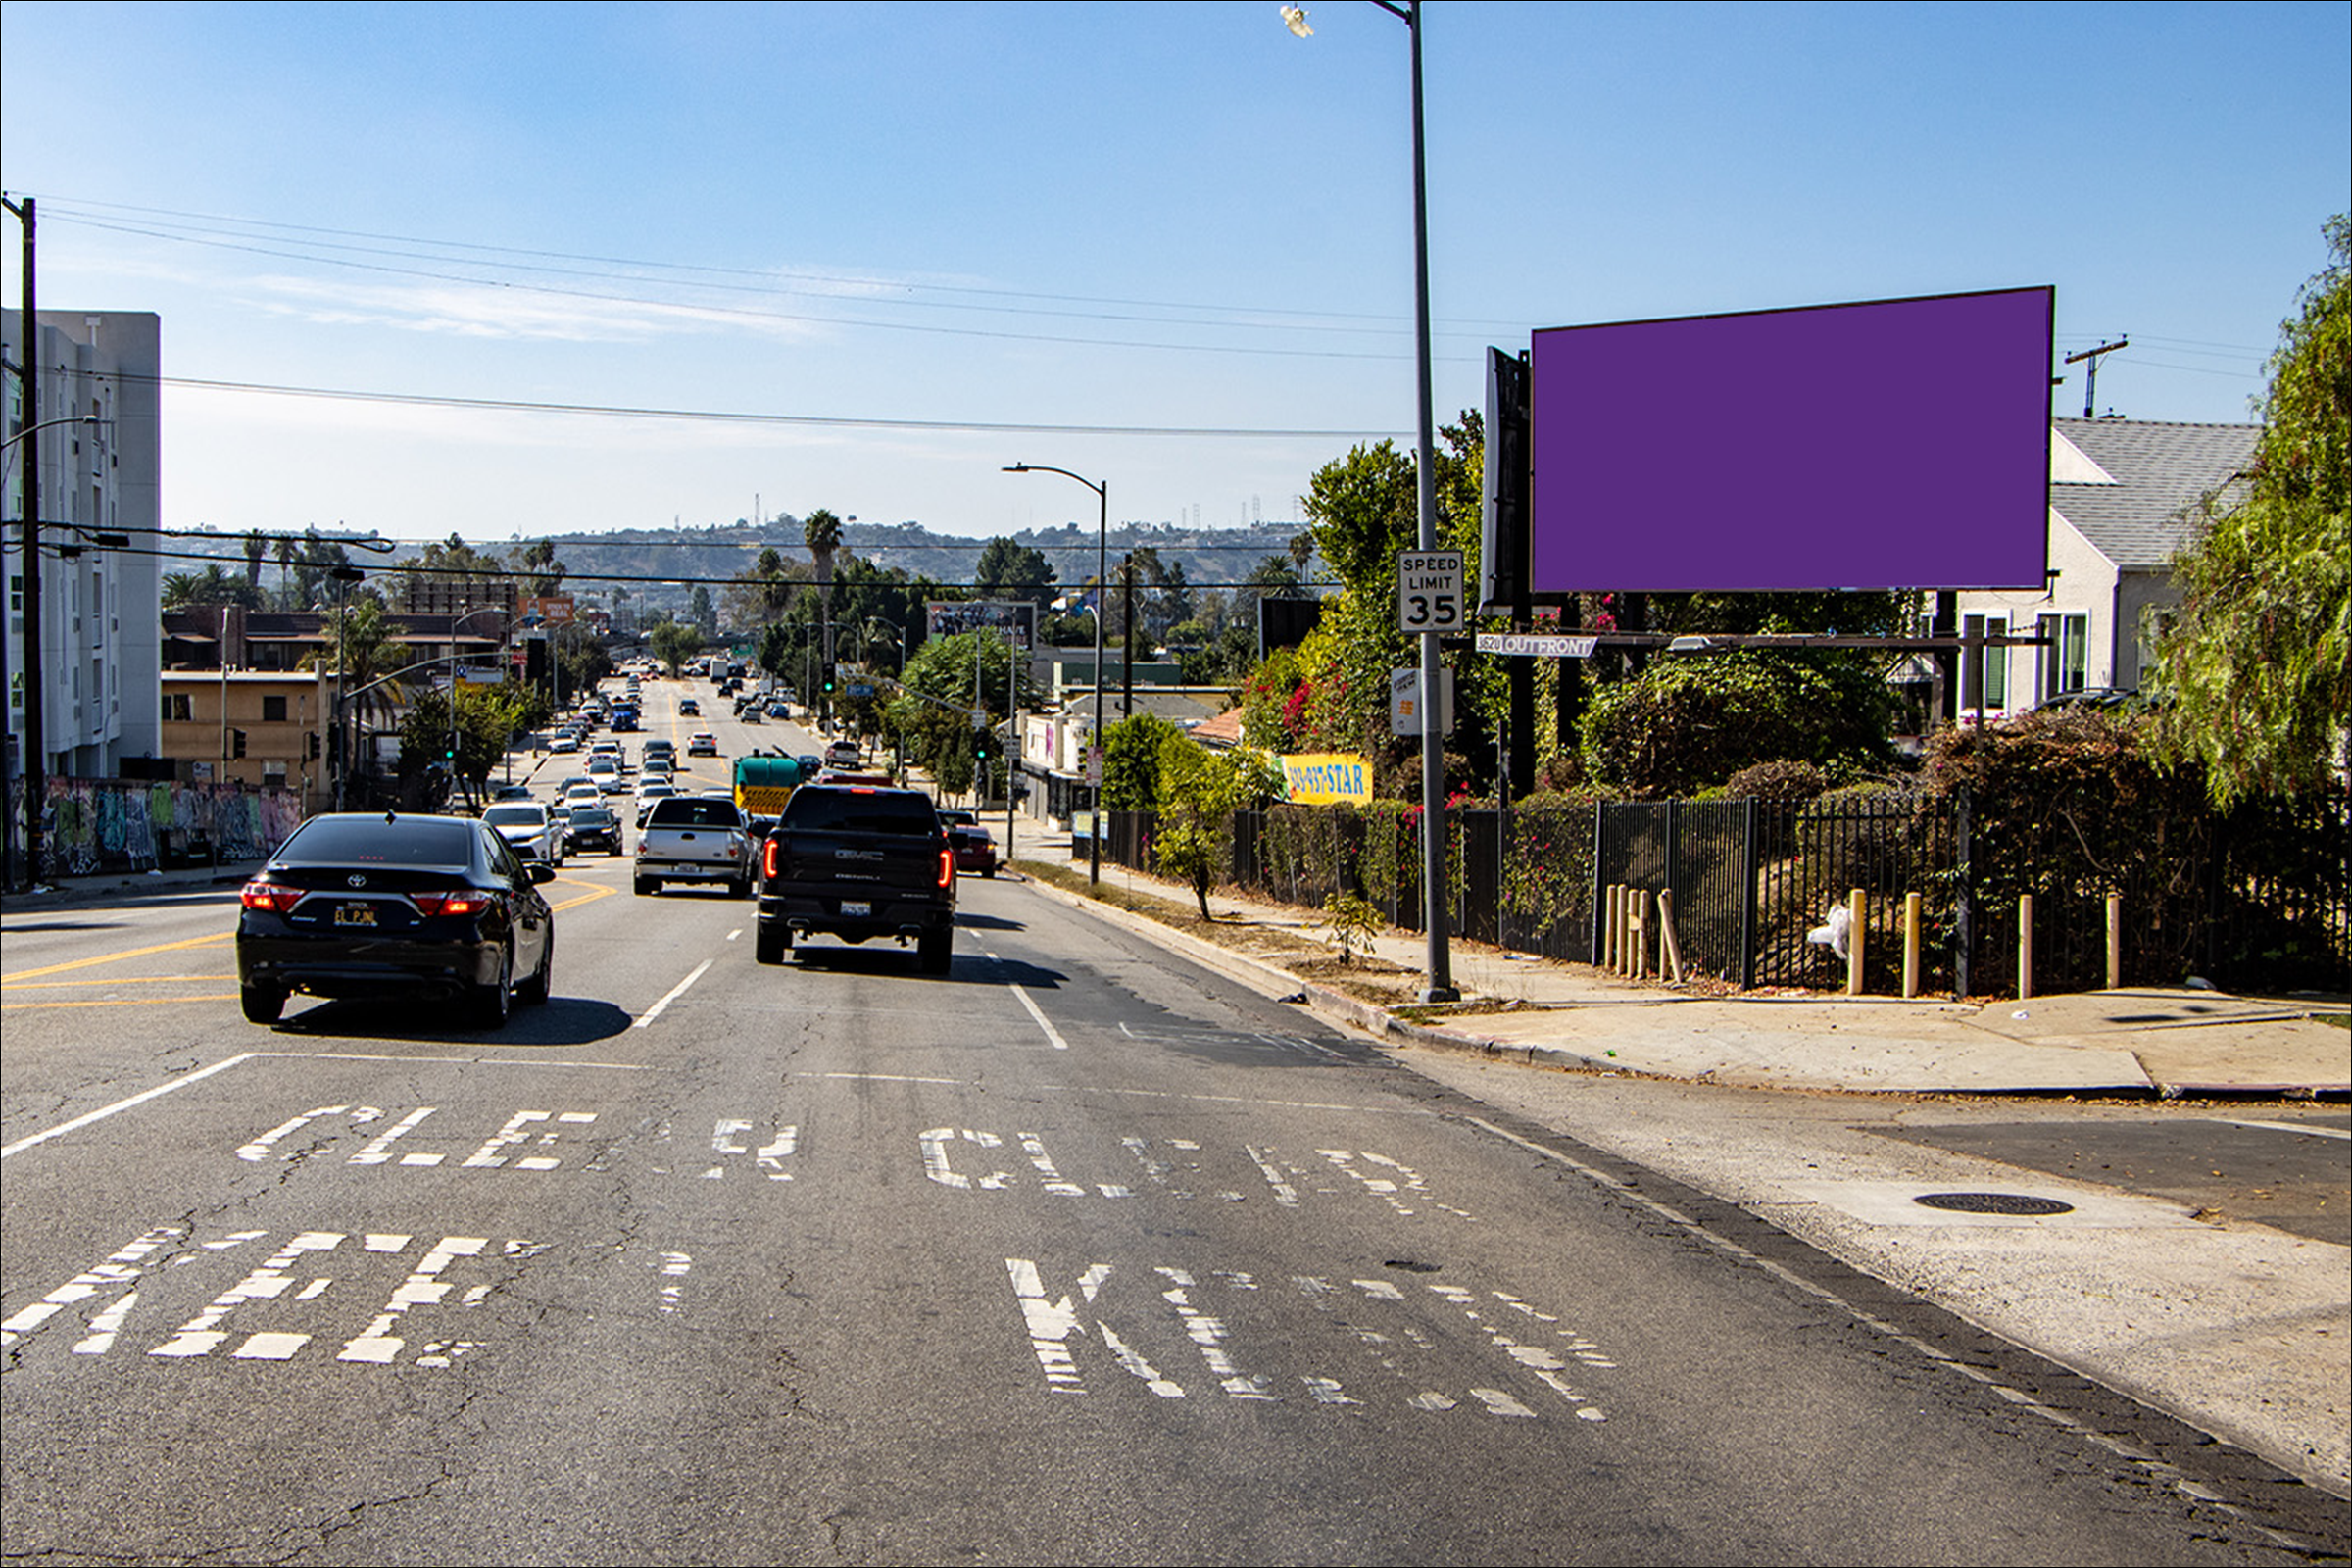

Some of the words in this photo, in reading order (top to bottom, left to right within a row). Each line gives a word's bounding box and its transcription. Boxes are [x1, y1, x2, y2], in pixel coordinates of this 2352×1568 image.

[1403, 557, 1458, 571] SPEED
[1409, 576, 1452, 590] LIMIT
[1406, 595, 1457, 625] 35
[1504, 637, 1592, 655] OUTFRONT
[235, 1105, 798, 1181] CLER
[0, 1227, 691, 1366] KEE
